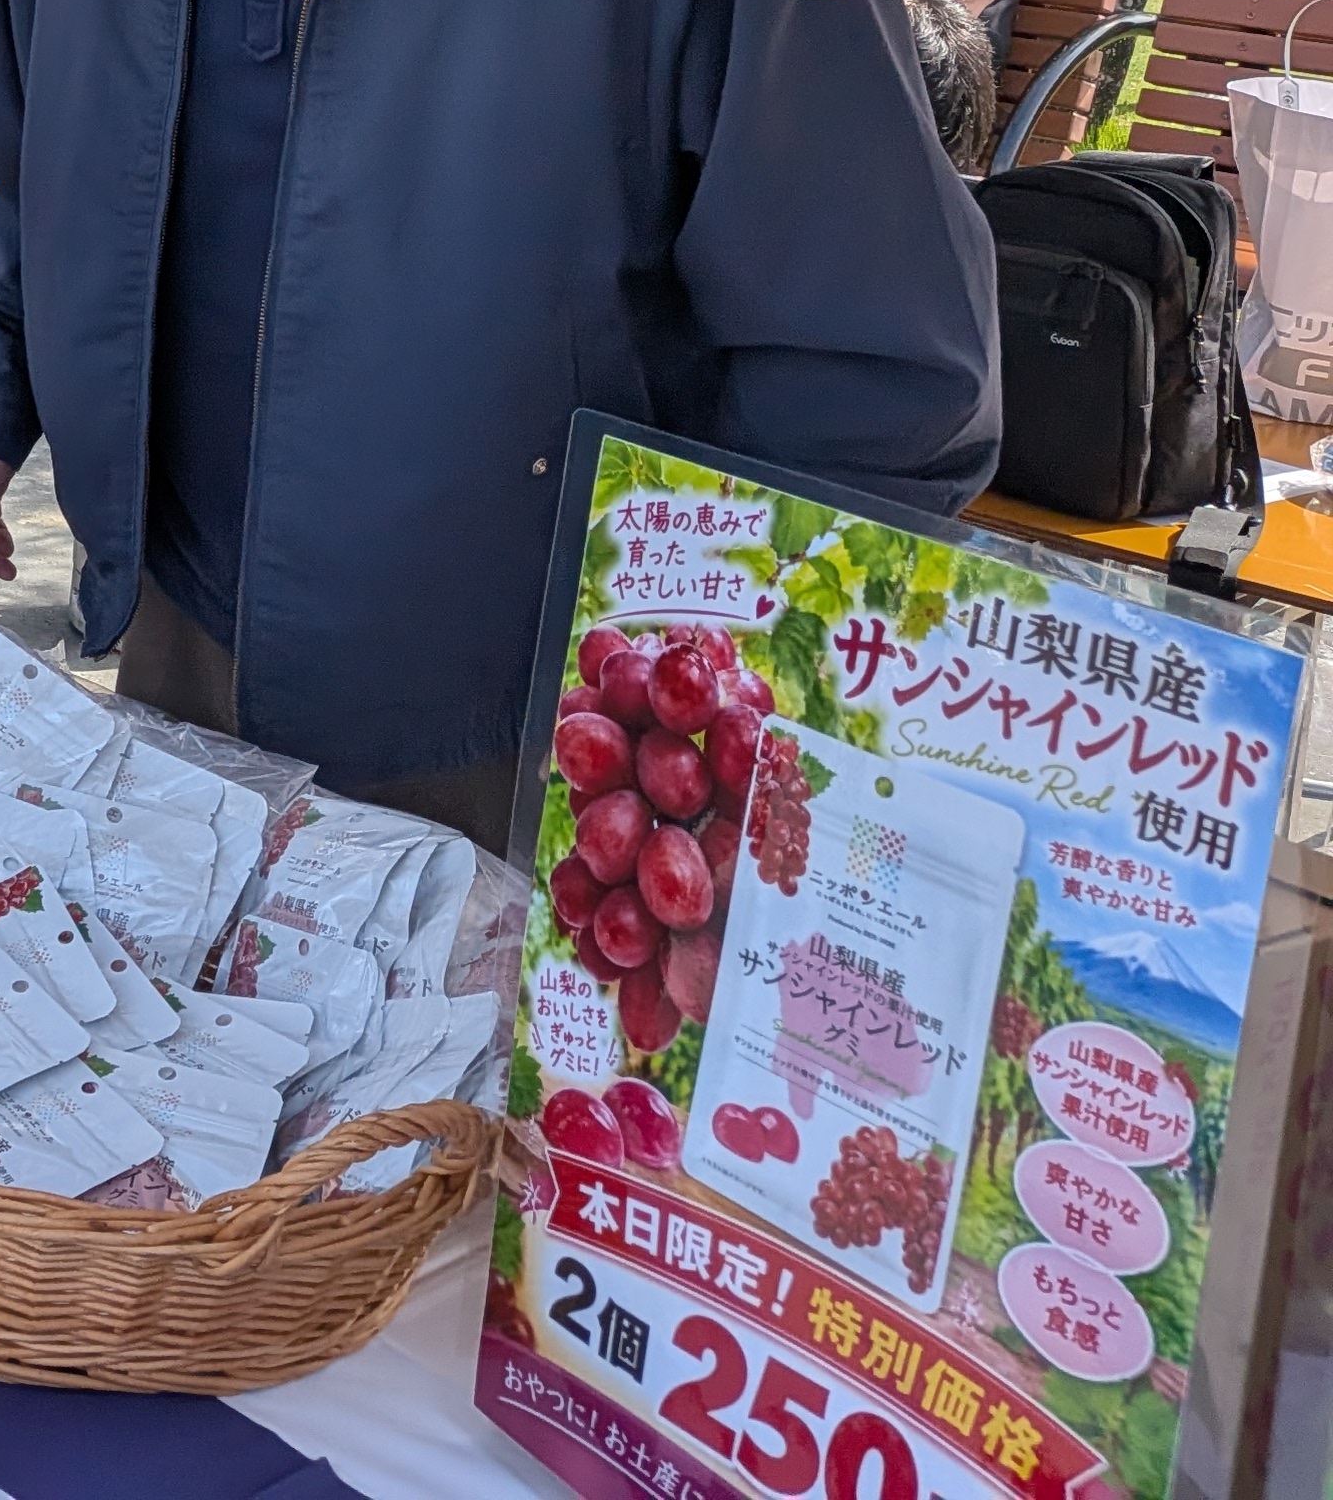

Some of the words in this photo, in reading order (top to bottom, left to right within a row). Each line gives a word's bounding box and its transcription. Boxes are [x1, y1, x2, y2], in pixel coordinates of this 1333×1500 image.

[1268, 302, 1333, 345] ニッ
[614, 499, 768, 538] 太陽の恵みで
[626, 536, 686, 569] 育った
[611, 570, 746, 602] やさしい甘さ
[966, 596, 1207, 725] 山梨県産
[833, 617, 1270, 808] サンシャインレッド
[890, 717, 1035, 786] Sunshine
[1035, 764, 1118, 815] Red
[1131, 788, 1240, 871] 使用
[1047, 839, 1174, 894] 芳醇な香りと
[808, 868, 927, 931] ニッポンエール
[1060, 875, 1200, 930] 爽やかな甘み
[539, 967, 593, 999] 山梨の
[809, 934, 906, 999] 山梨県産
[536, 995, 609, 1030] おいしさを
[550, 1022, 597, 1051] ぎゅっと
[737, 947, 968, 1077] サンシャインレッド
[824, 1024, 861, 1057] グミ
[549, 1047, 600, 1077] グミに!
[1066, 1040, 1160, 1098] 山梨県産
[1032, 1050, 1191, 1139] サンシャインレッド
[1060, 1092, 1151, 1153] 果汁使用
[1044, 1160, 1142, 1227] 爽やかな
[1062, 1201, 1114, 1248] 甘さ
[547, 1255, 652, 1386] 2個
[1033, 1263, 1123, 1332] もちっと
[578, 1181, 797, 1318] 本日限定!
[806, 1286, 1043, 1484] 特別価格
[1043, 1304, 1101, 1355] 食感
[503, 1360, 600, 1438] おやつに!
